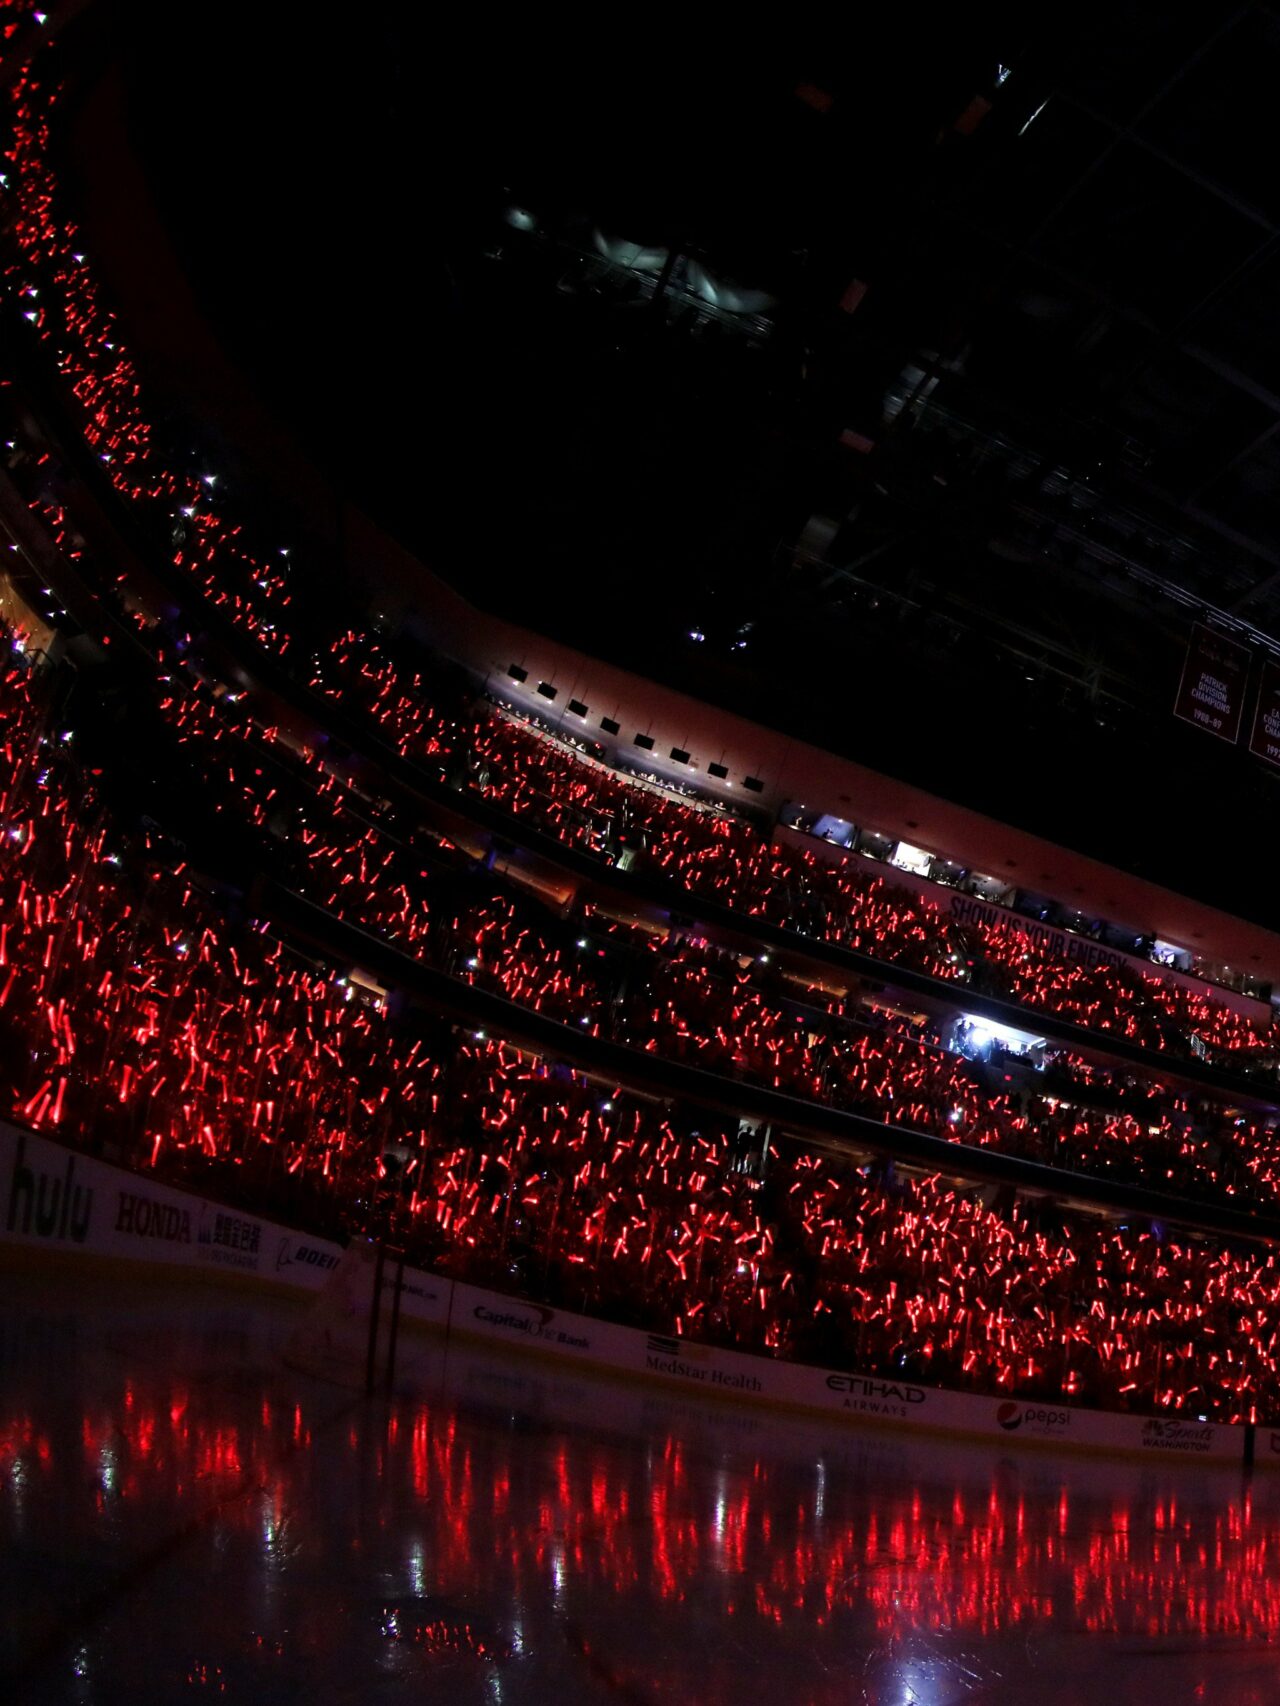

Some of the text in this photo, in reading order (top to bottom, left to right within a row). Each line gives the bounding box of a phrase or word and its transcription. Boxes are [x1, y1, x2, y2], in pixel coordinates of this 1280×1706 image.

[1198, 681, 1228, 703] DIVISION
[1201, 672, 1228, 692] PATRICK
[1191, 688, 1231, 714] CHAMPIONS
[950, 896, 997, 928] SHOW
[1001, 914, 1021, 935] US
[1026, 923, 1065, 953] YOUR
[6, 1136, 94, 1243] hulu
[115, 1191, 191, 1244] HONDA
[558, 1332, 590, 1349] Bank
[646, 1355, 762, 1392] MedStar Health
[826, 1375, 926, 1404] ETIHAD
[843, 1398, 906, 1417] AIRWAYS
[1025, 1409, 1070, 1426] pepsi
[1165, 1421, 1216, 1441] Sports
[1143, 1437, 1210, 1453] WASHINGTON
